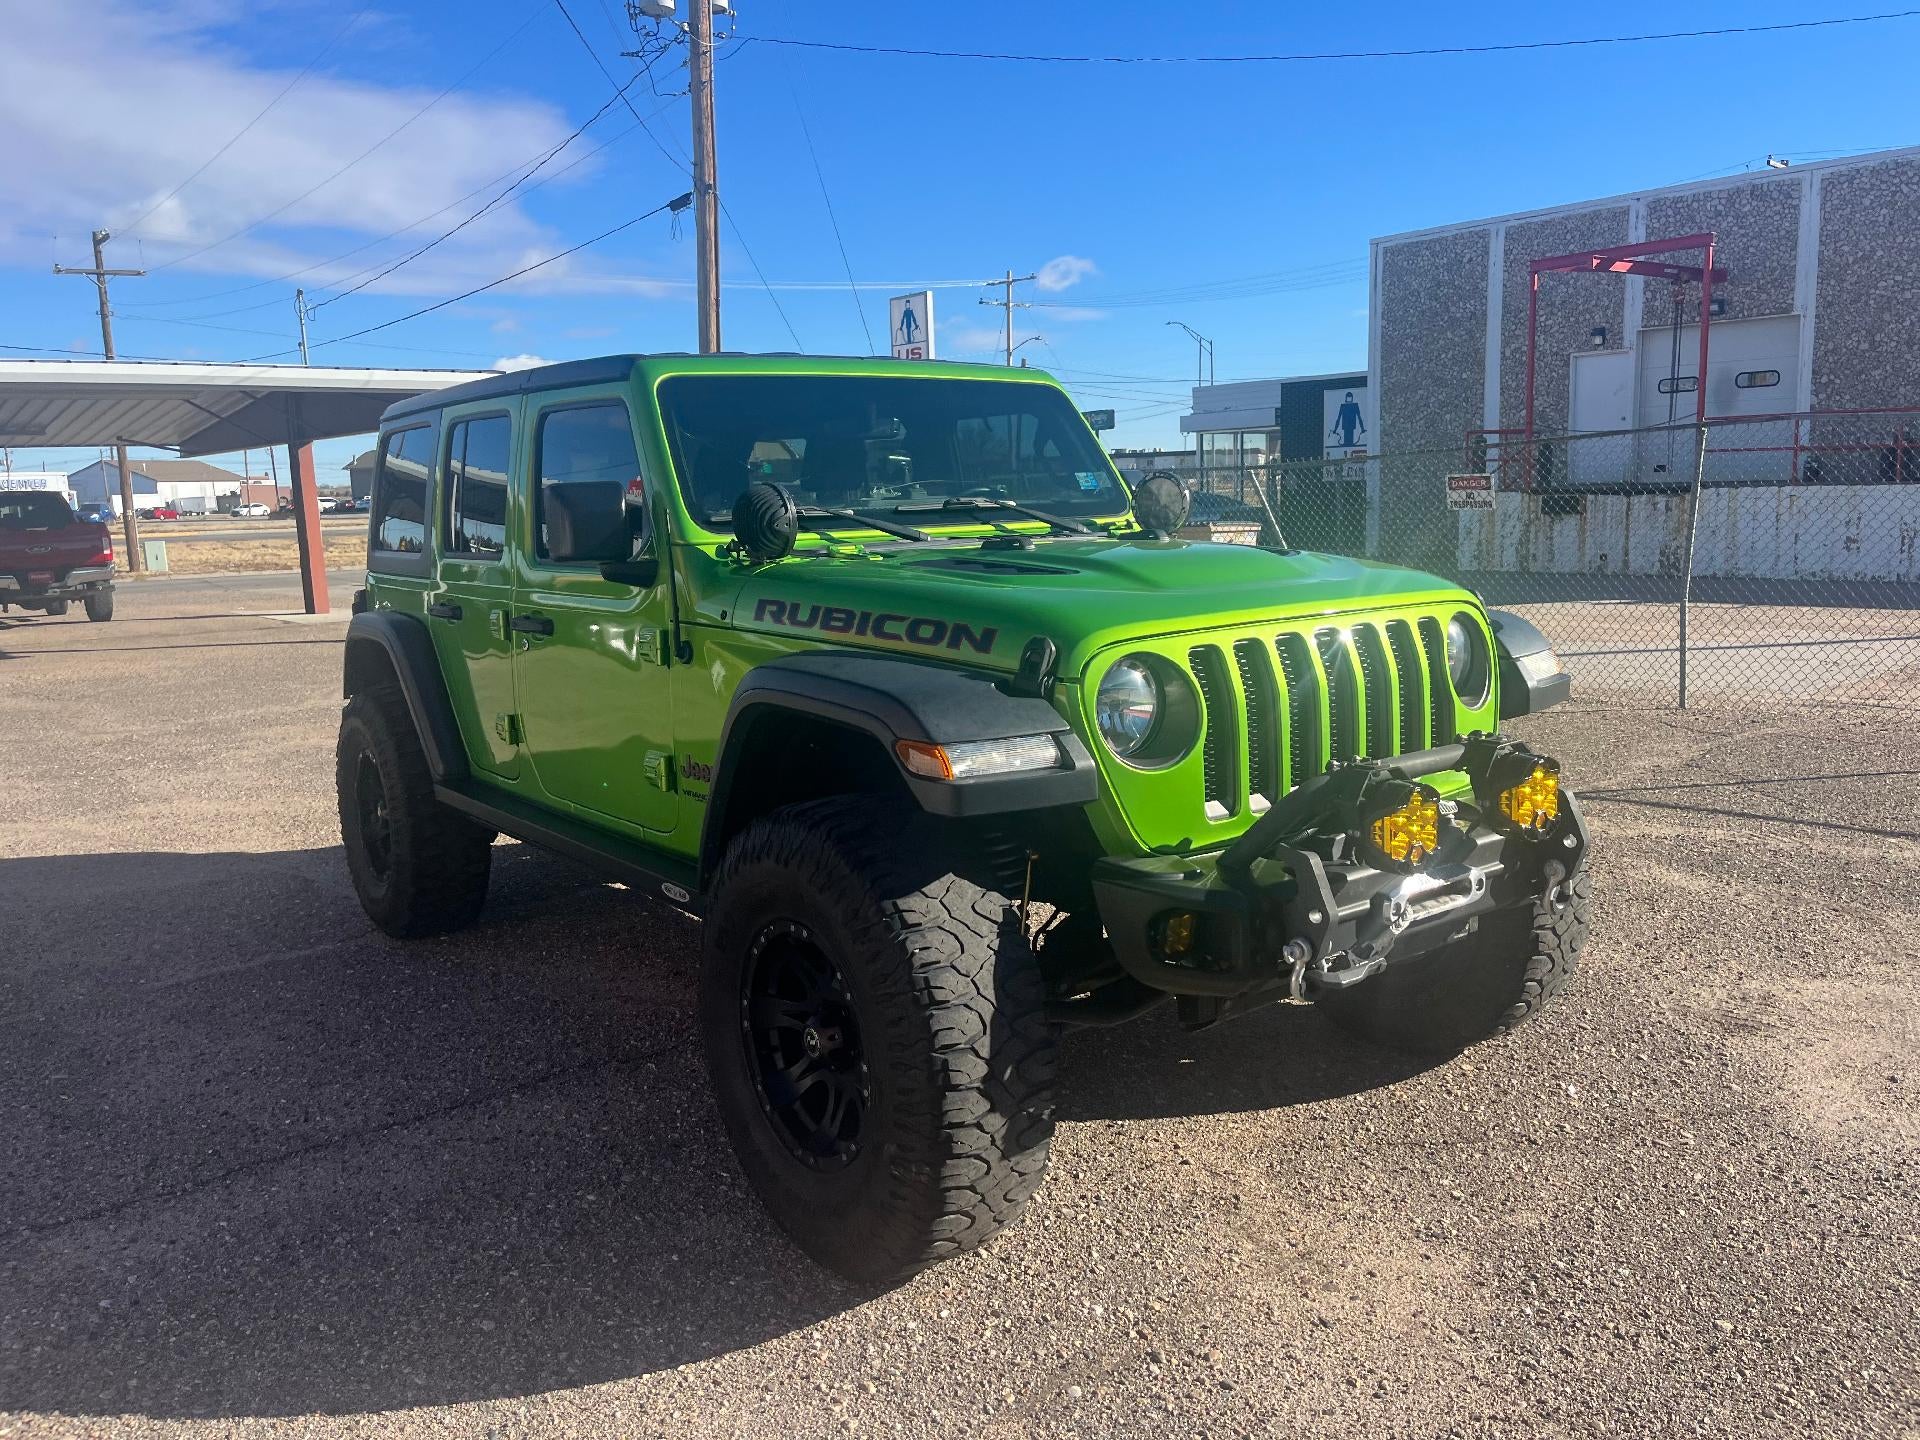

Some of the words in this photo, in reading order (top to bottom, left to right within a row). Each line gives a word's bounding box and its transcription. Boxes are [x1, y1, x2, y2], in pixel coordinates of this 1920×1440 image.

[1450, 500, 1493, 509] TRESPASSING
[1465, 491, 1475, 500] NO
[753, 598, 998, 654] RUBICON
[680, 754, 711, 783] Jee
